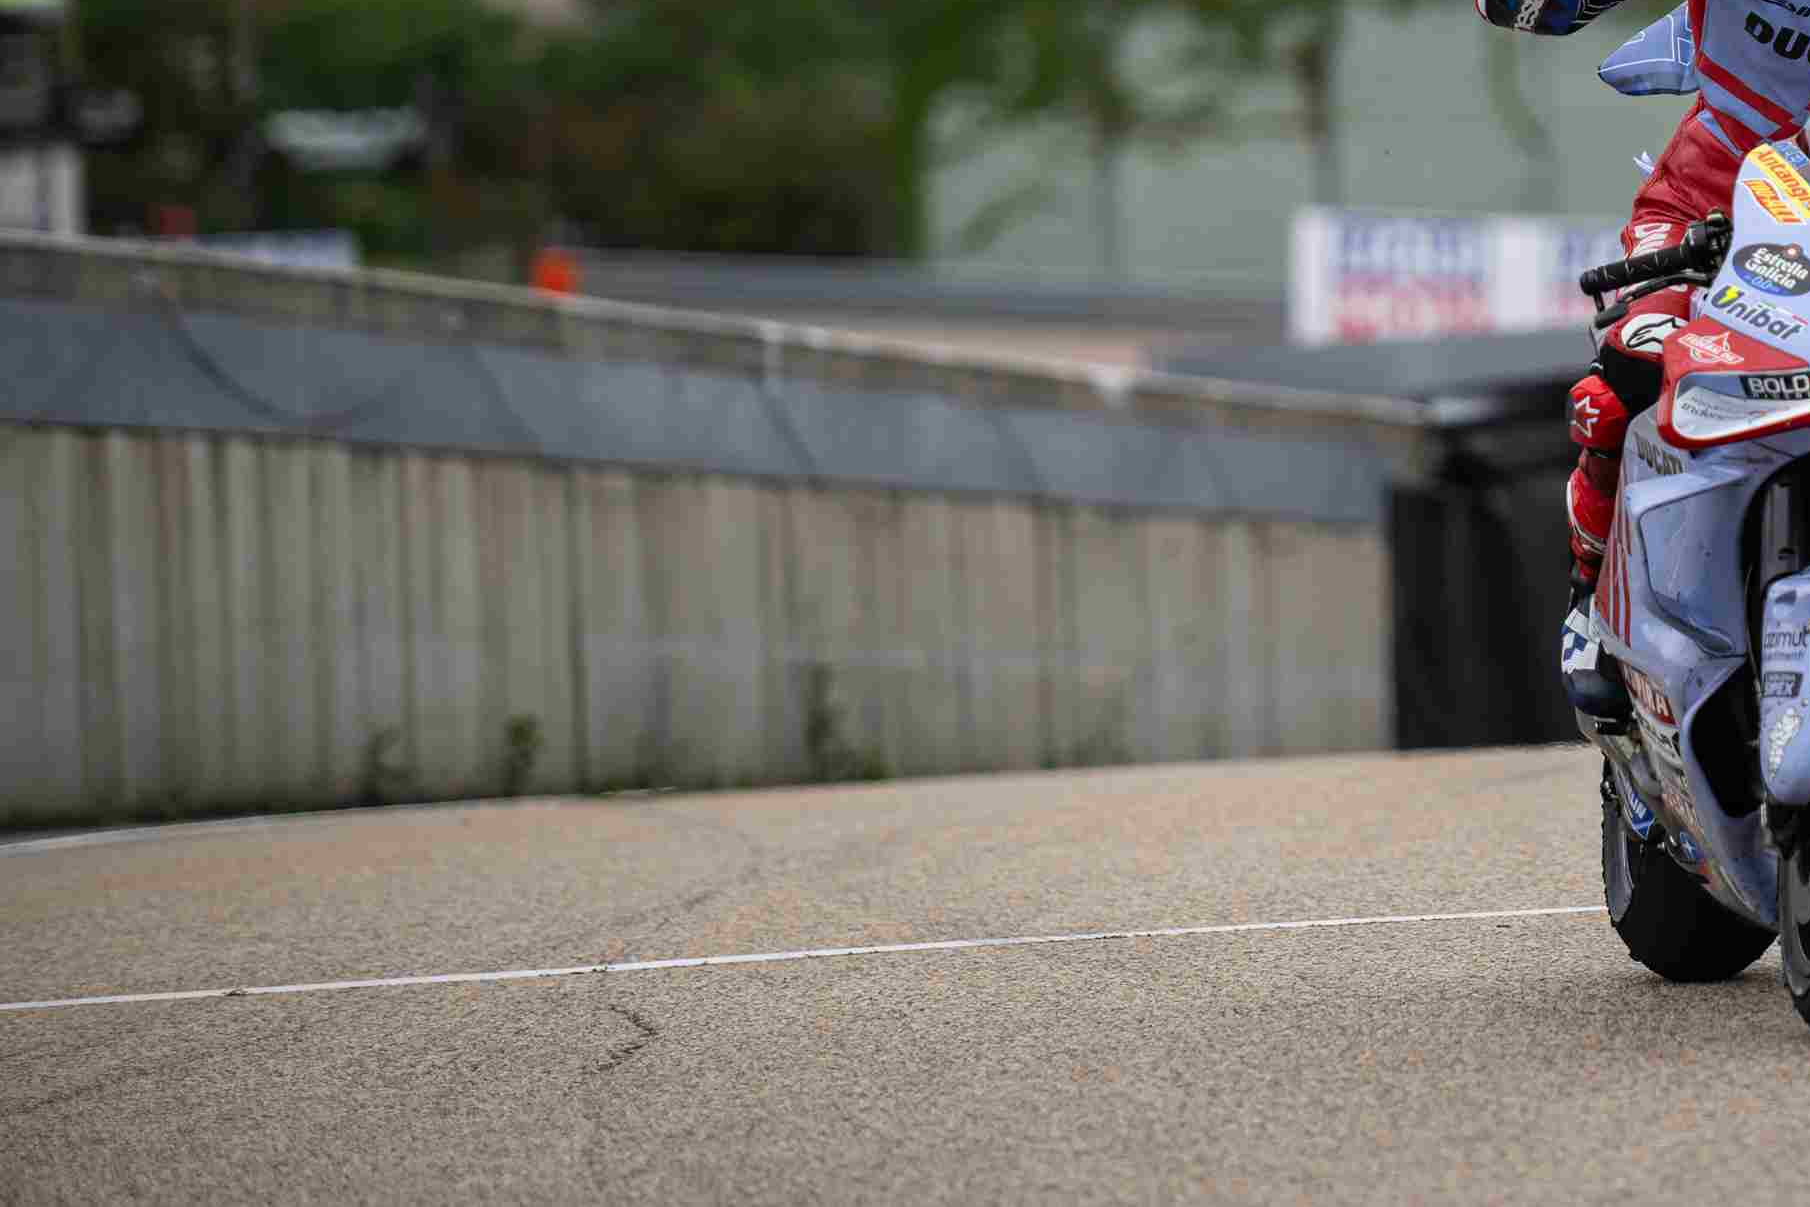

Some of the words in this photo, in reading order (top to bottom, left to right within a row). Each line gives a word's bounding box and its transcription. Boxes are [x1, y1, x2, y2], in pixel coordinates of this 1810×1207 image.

[1744, 259, 1798, 290] Galicia
[1751, 247, 1809, 280] Estrella
[1711, 285, 1804, 341] Unibat
[1748, 374, 1810, 394] BOLD
